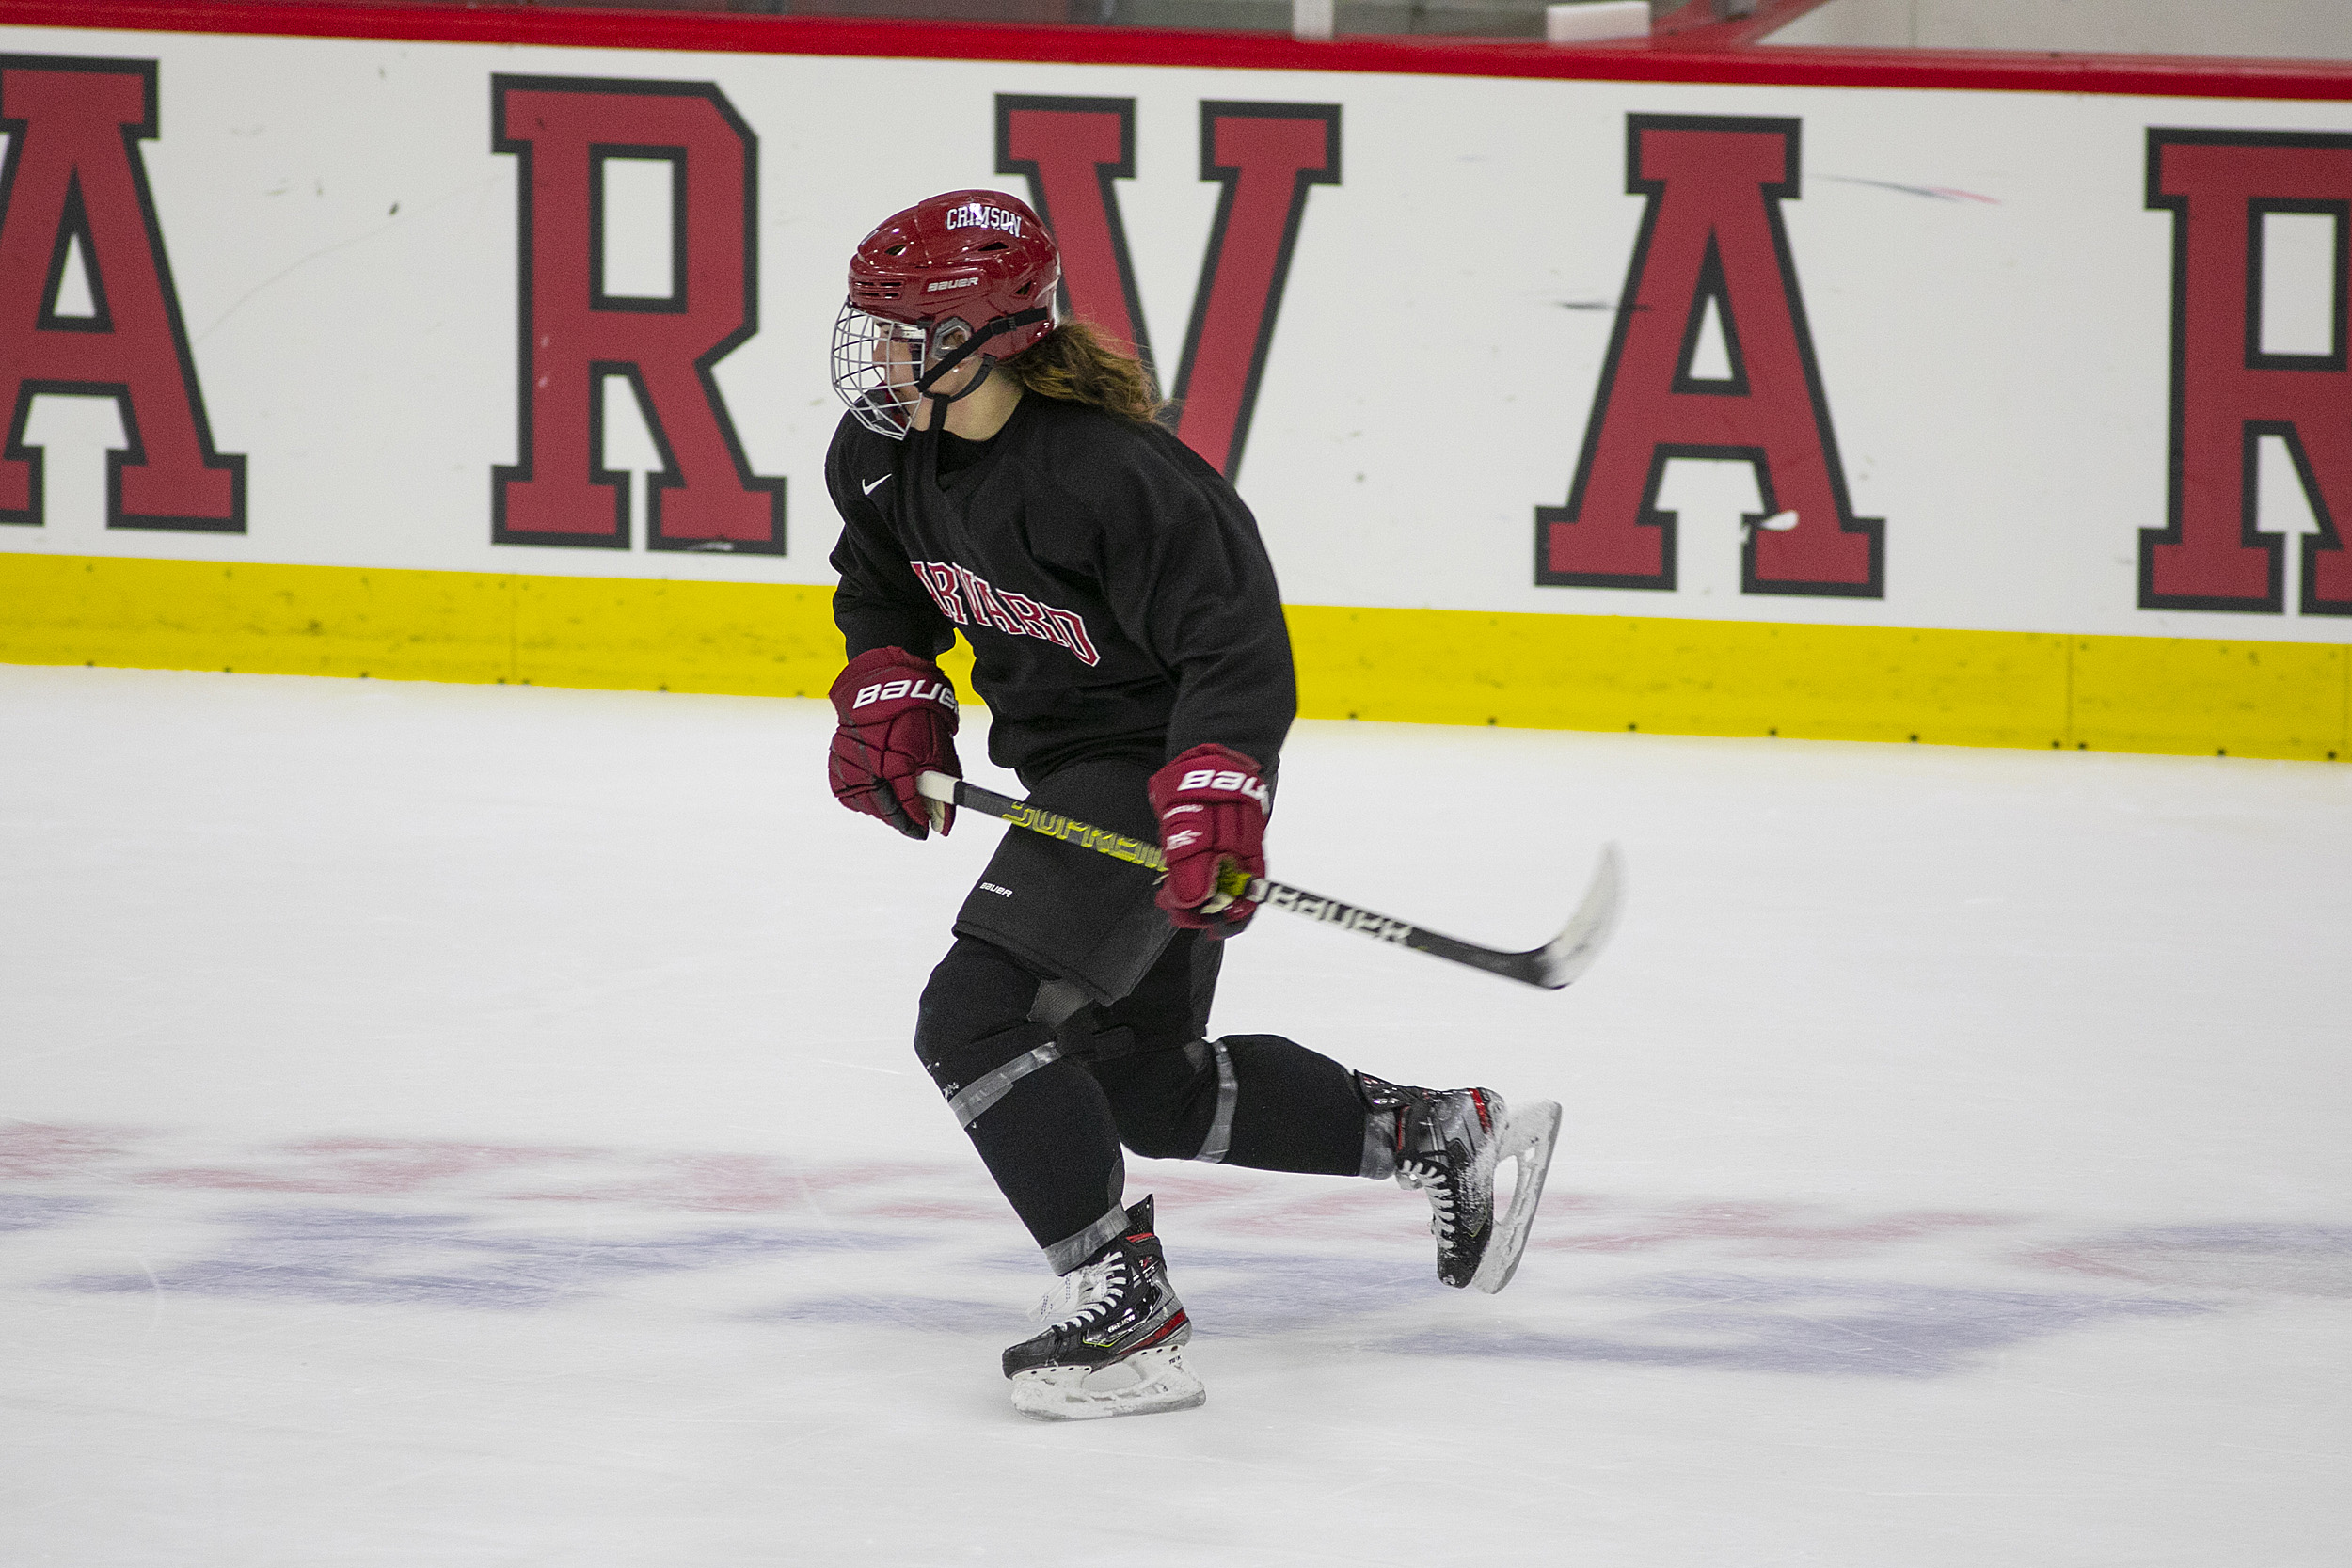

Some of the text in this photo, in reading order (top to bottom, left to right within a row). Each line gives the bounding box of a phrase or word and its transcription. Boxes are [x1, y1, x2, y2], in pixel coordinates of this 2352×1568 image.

[946, 202, 1022, 238] CRIMSON
[927, 277, 979, 292] BAUER
[852, 679, 958, 712] BAUE
[1177, 769, 1270, 816] BAU
[979, 882, 1013, 898] BAUER
